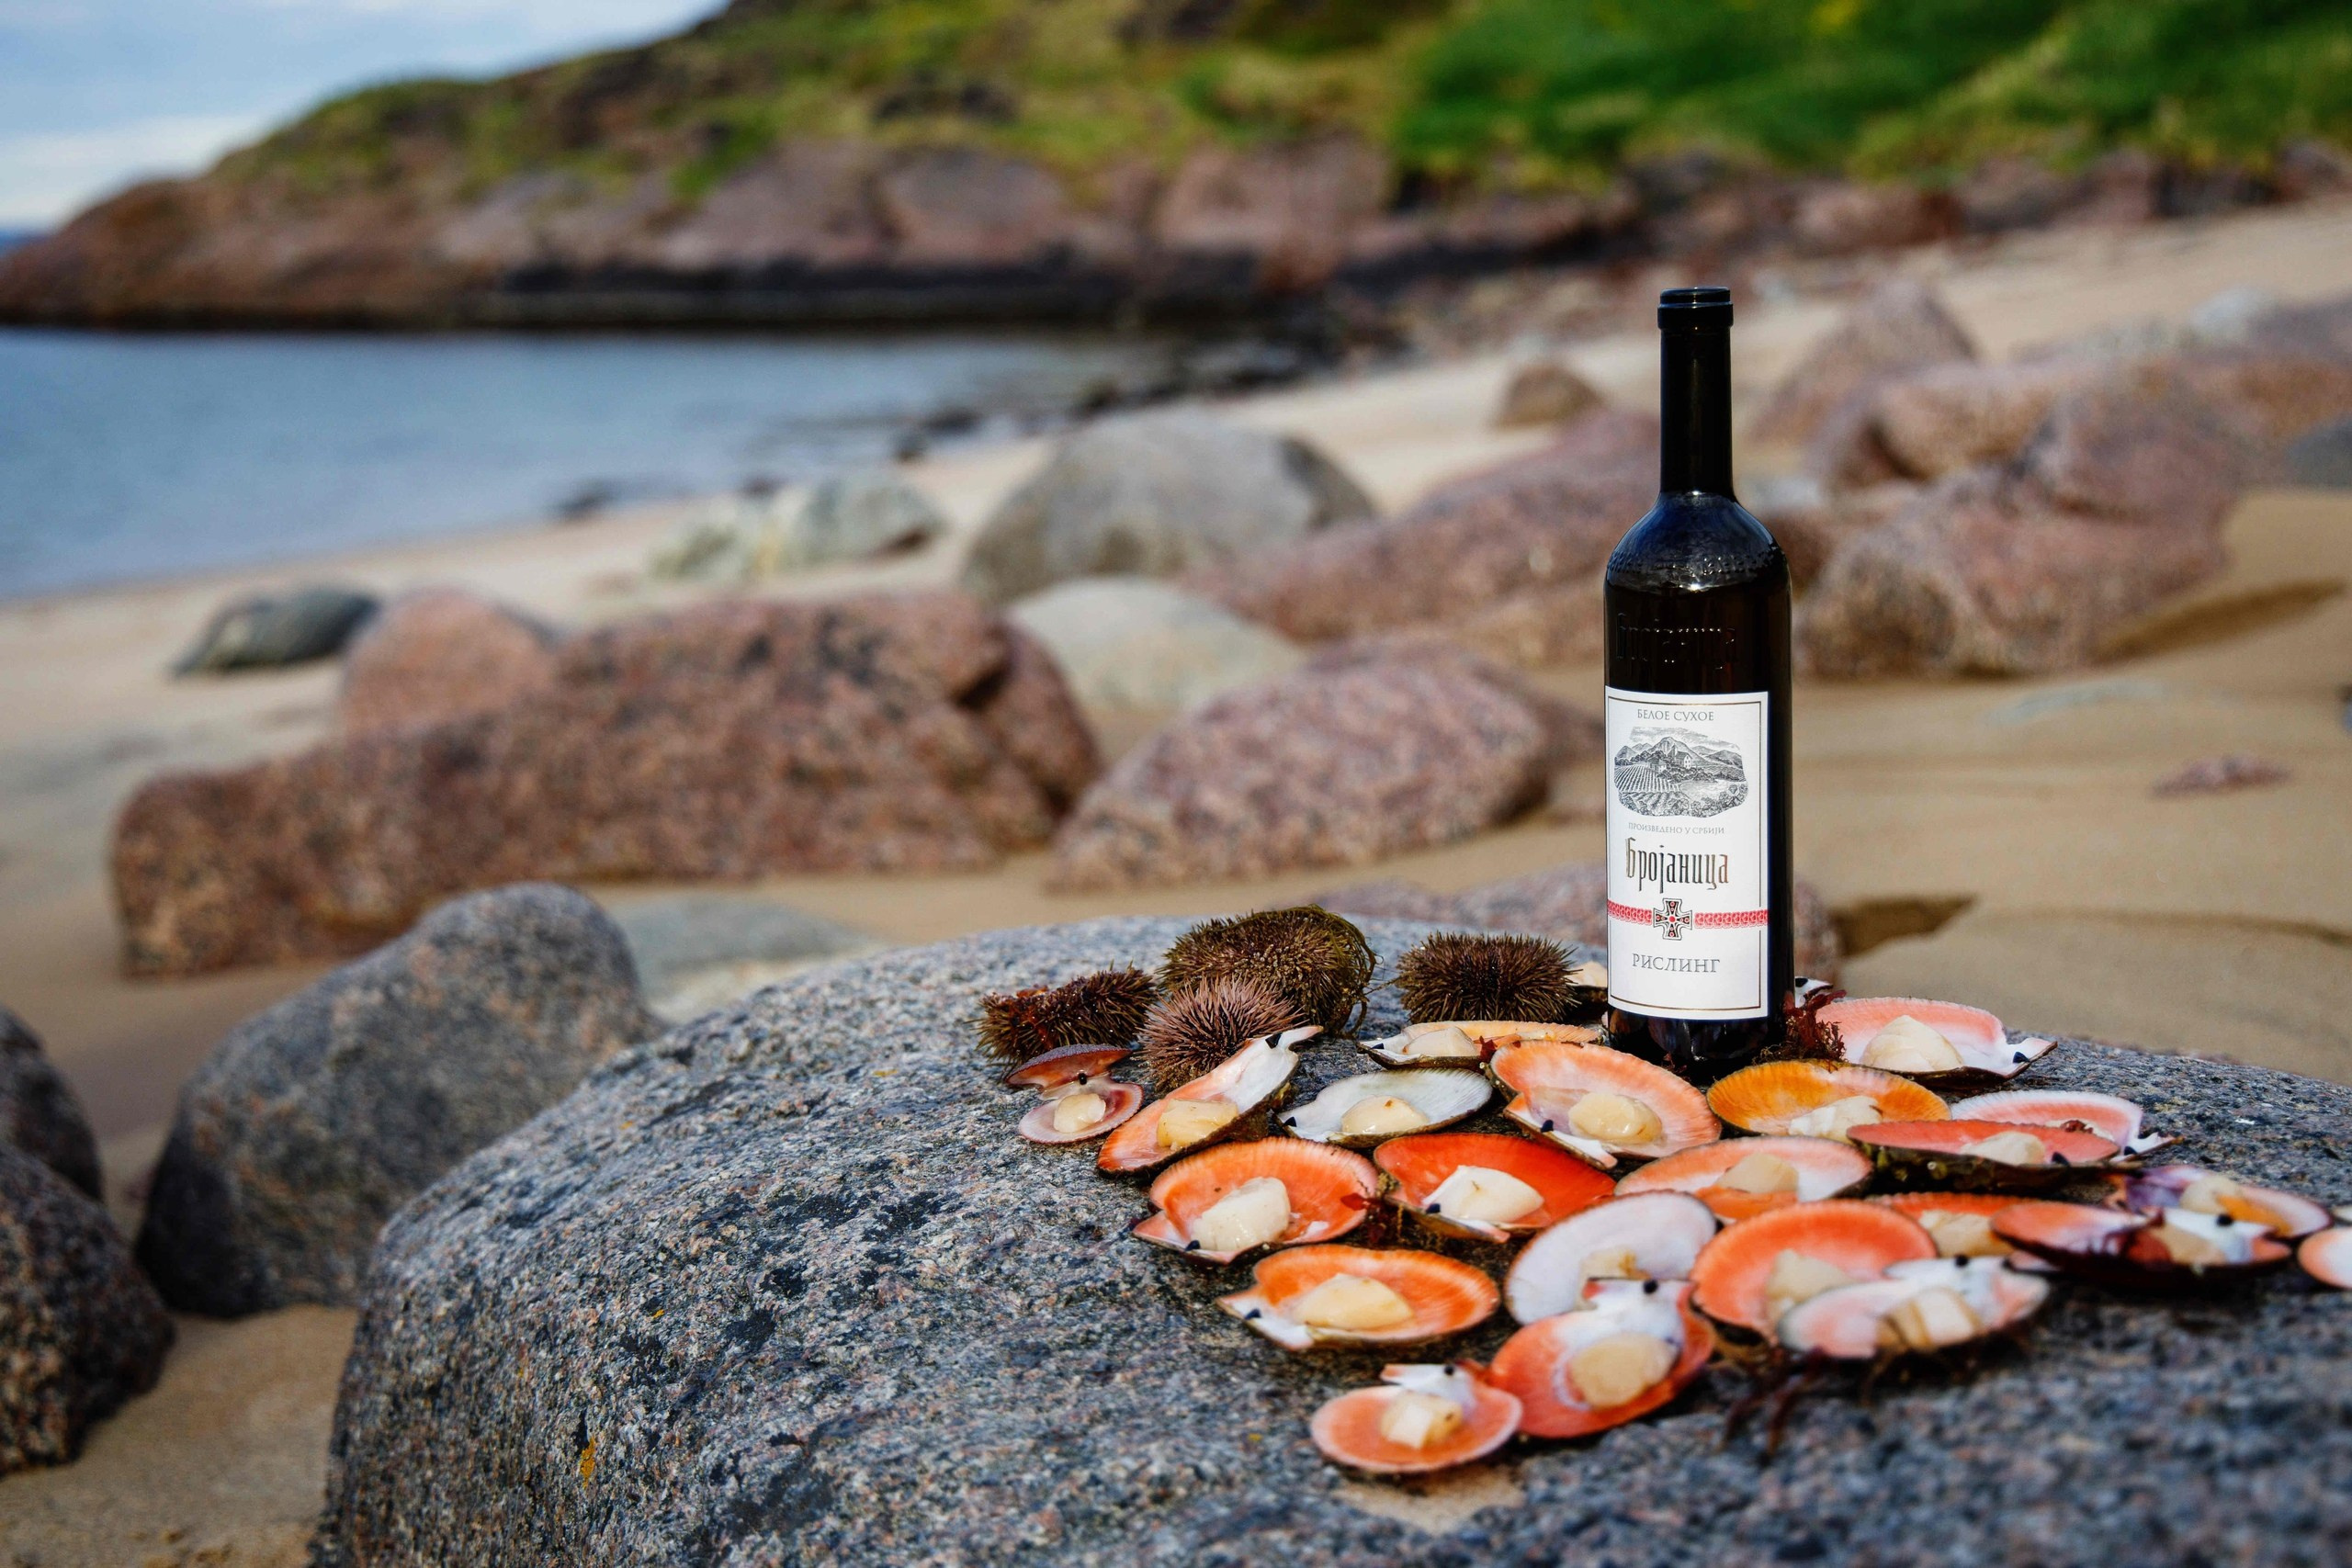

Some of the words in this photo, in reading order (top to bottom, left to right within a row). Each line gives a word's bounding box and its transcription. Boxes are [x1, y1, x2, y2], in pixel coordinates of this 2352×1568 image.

[1637, 709, 1670, 721] БЕЛОЕ
[1674, 711, 1714, 721] СУХОЕ
[1628, 822, 1683, 834] ПРОИЗВЕДЕНО
[1685, 827, 1690, 835] У
[1692, 827, 1724, 835] СРБИЈИ
[1632, 953, 1721, 973] РИСЛИНГ
